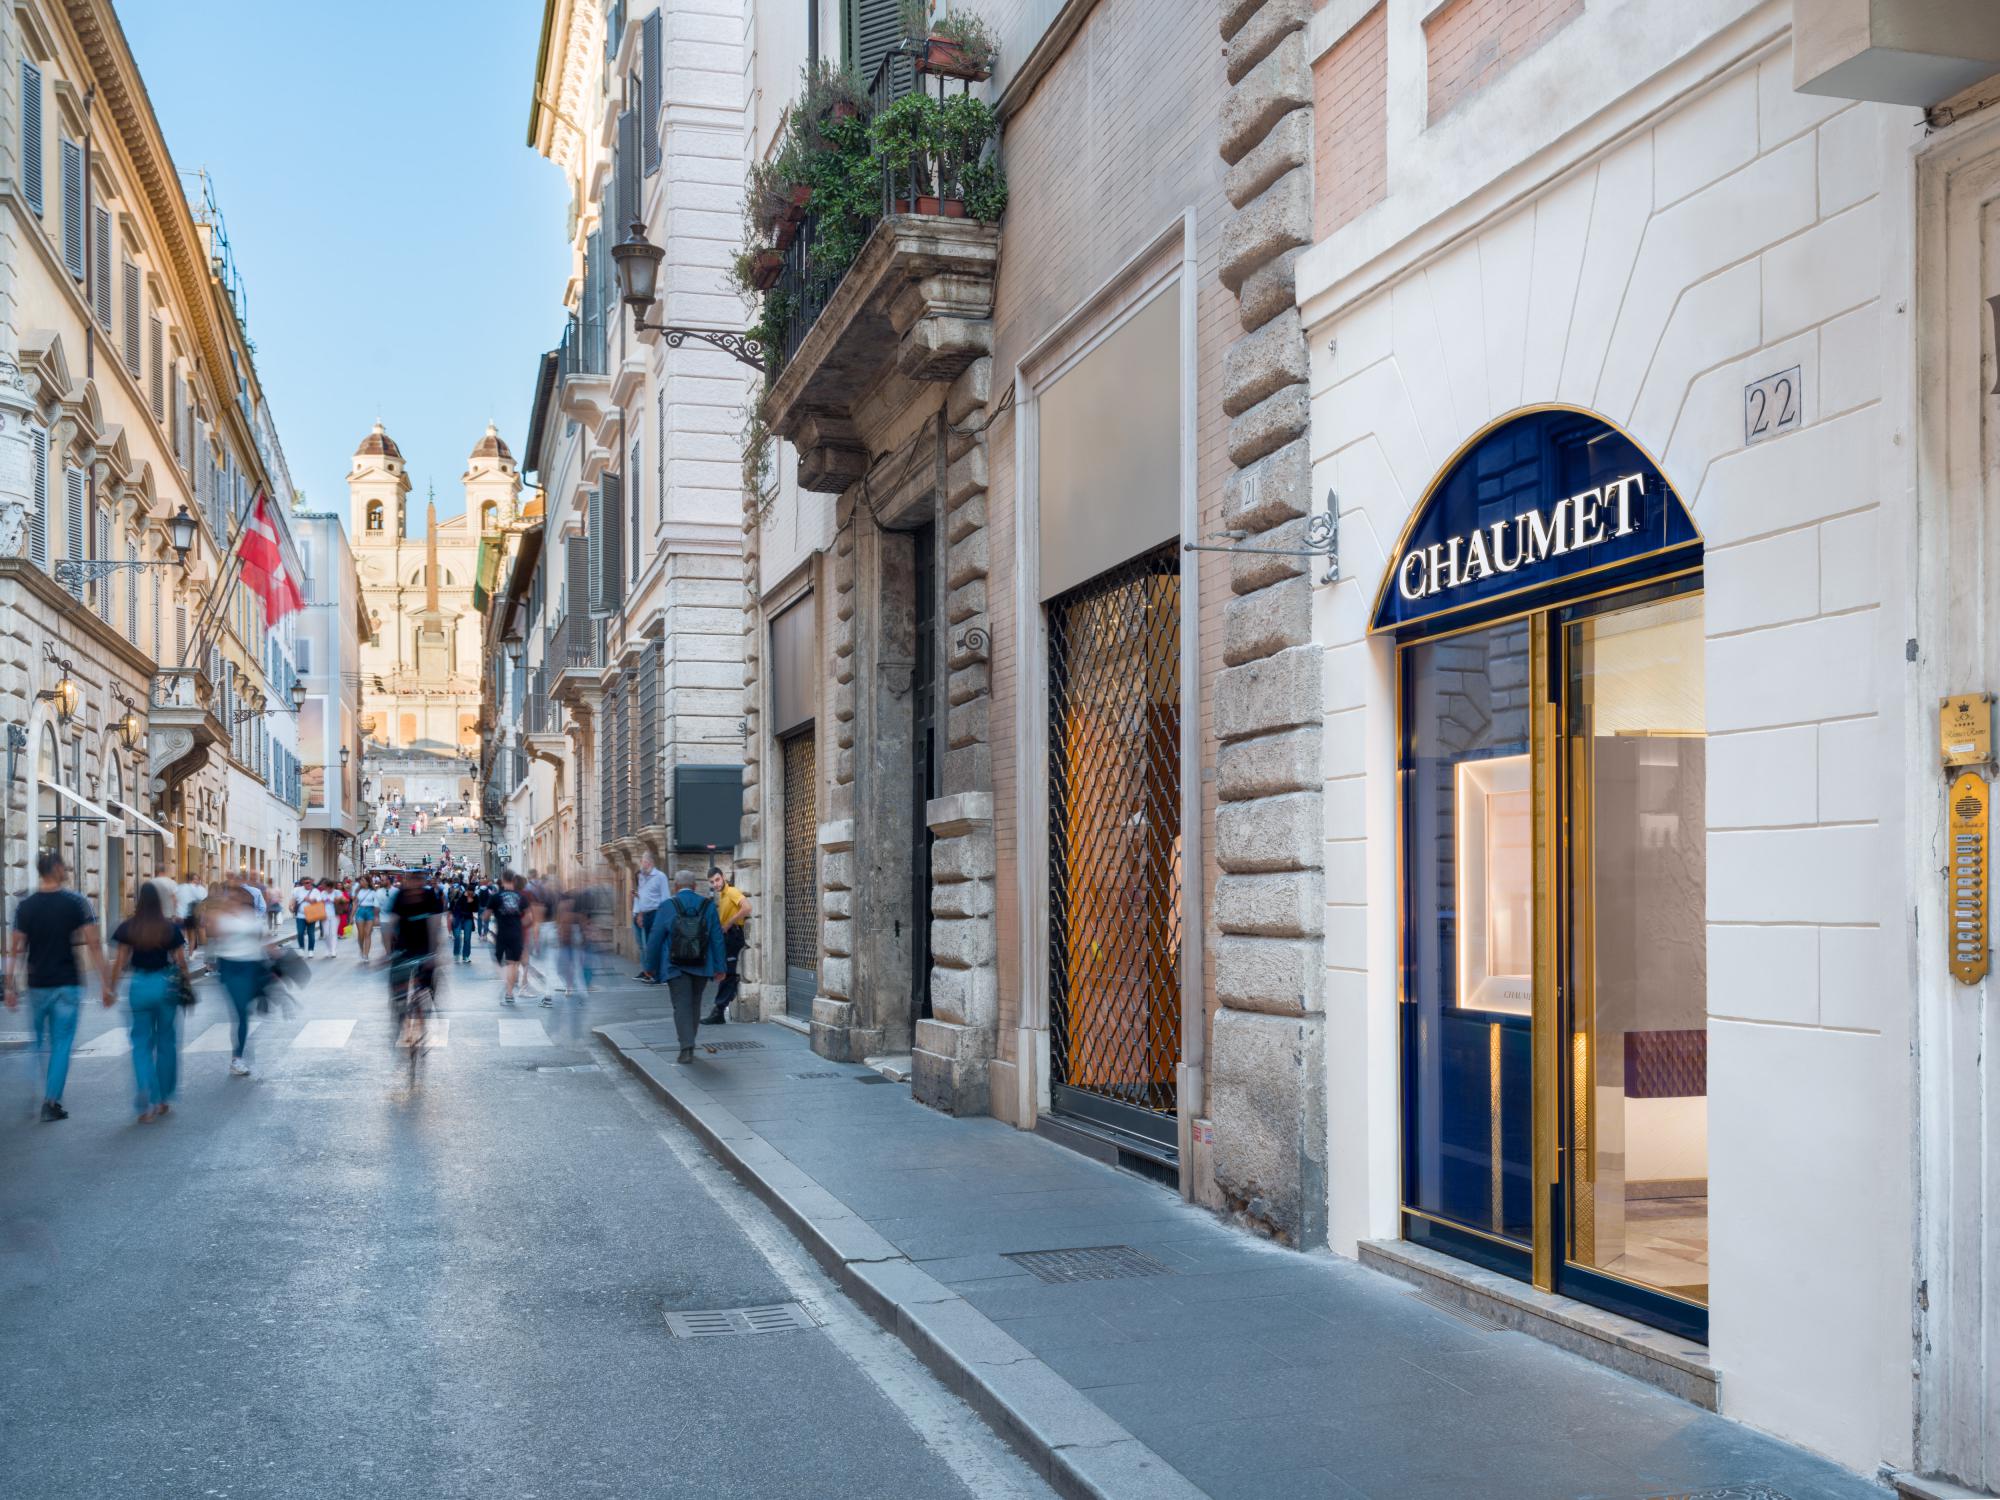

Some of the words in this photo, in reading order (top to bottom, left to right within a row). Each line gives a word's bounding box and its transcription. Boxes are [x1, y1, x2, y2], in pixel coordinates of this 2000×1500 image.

[1750, 378, 1796, 436] 22
[1245, 478, 1255, 505] 21
[1398, 473, 1645, 600] CHAUMET
